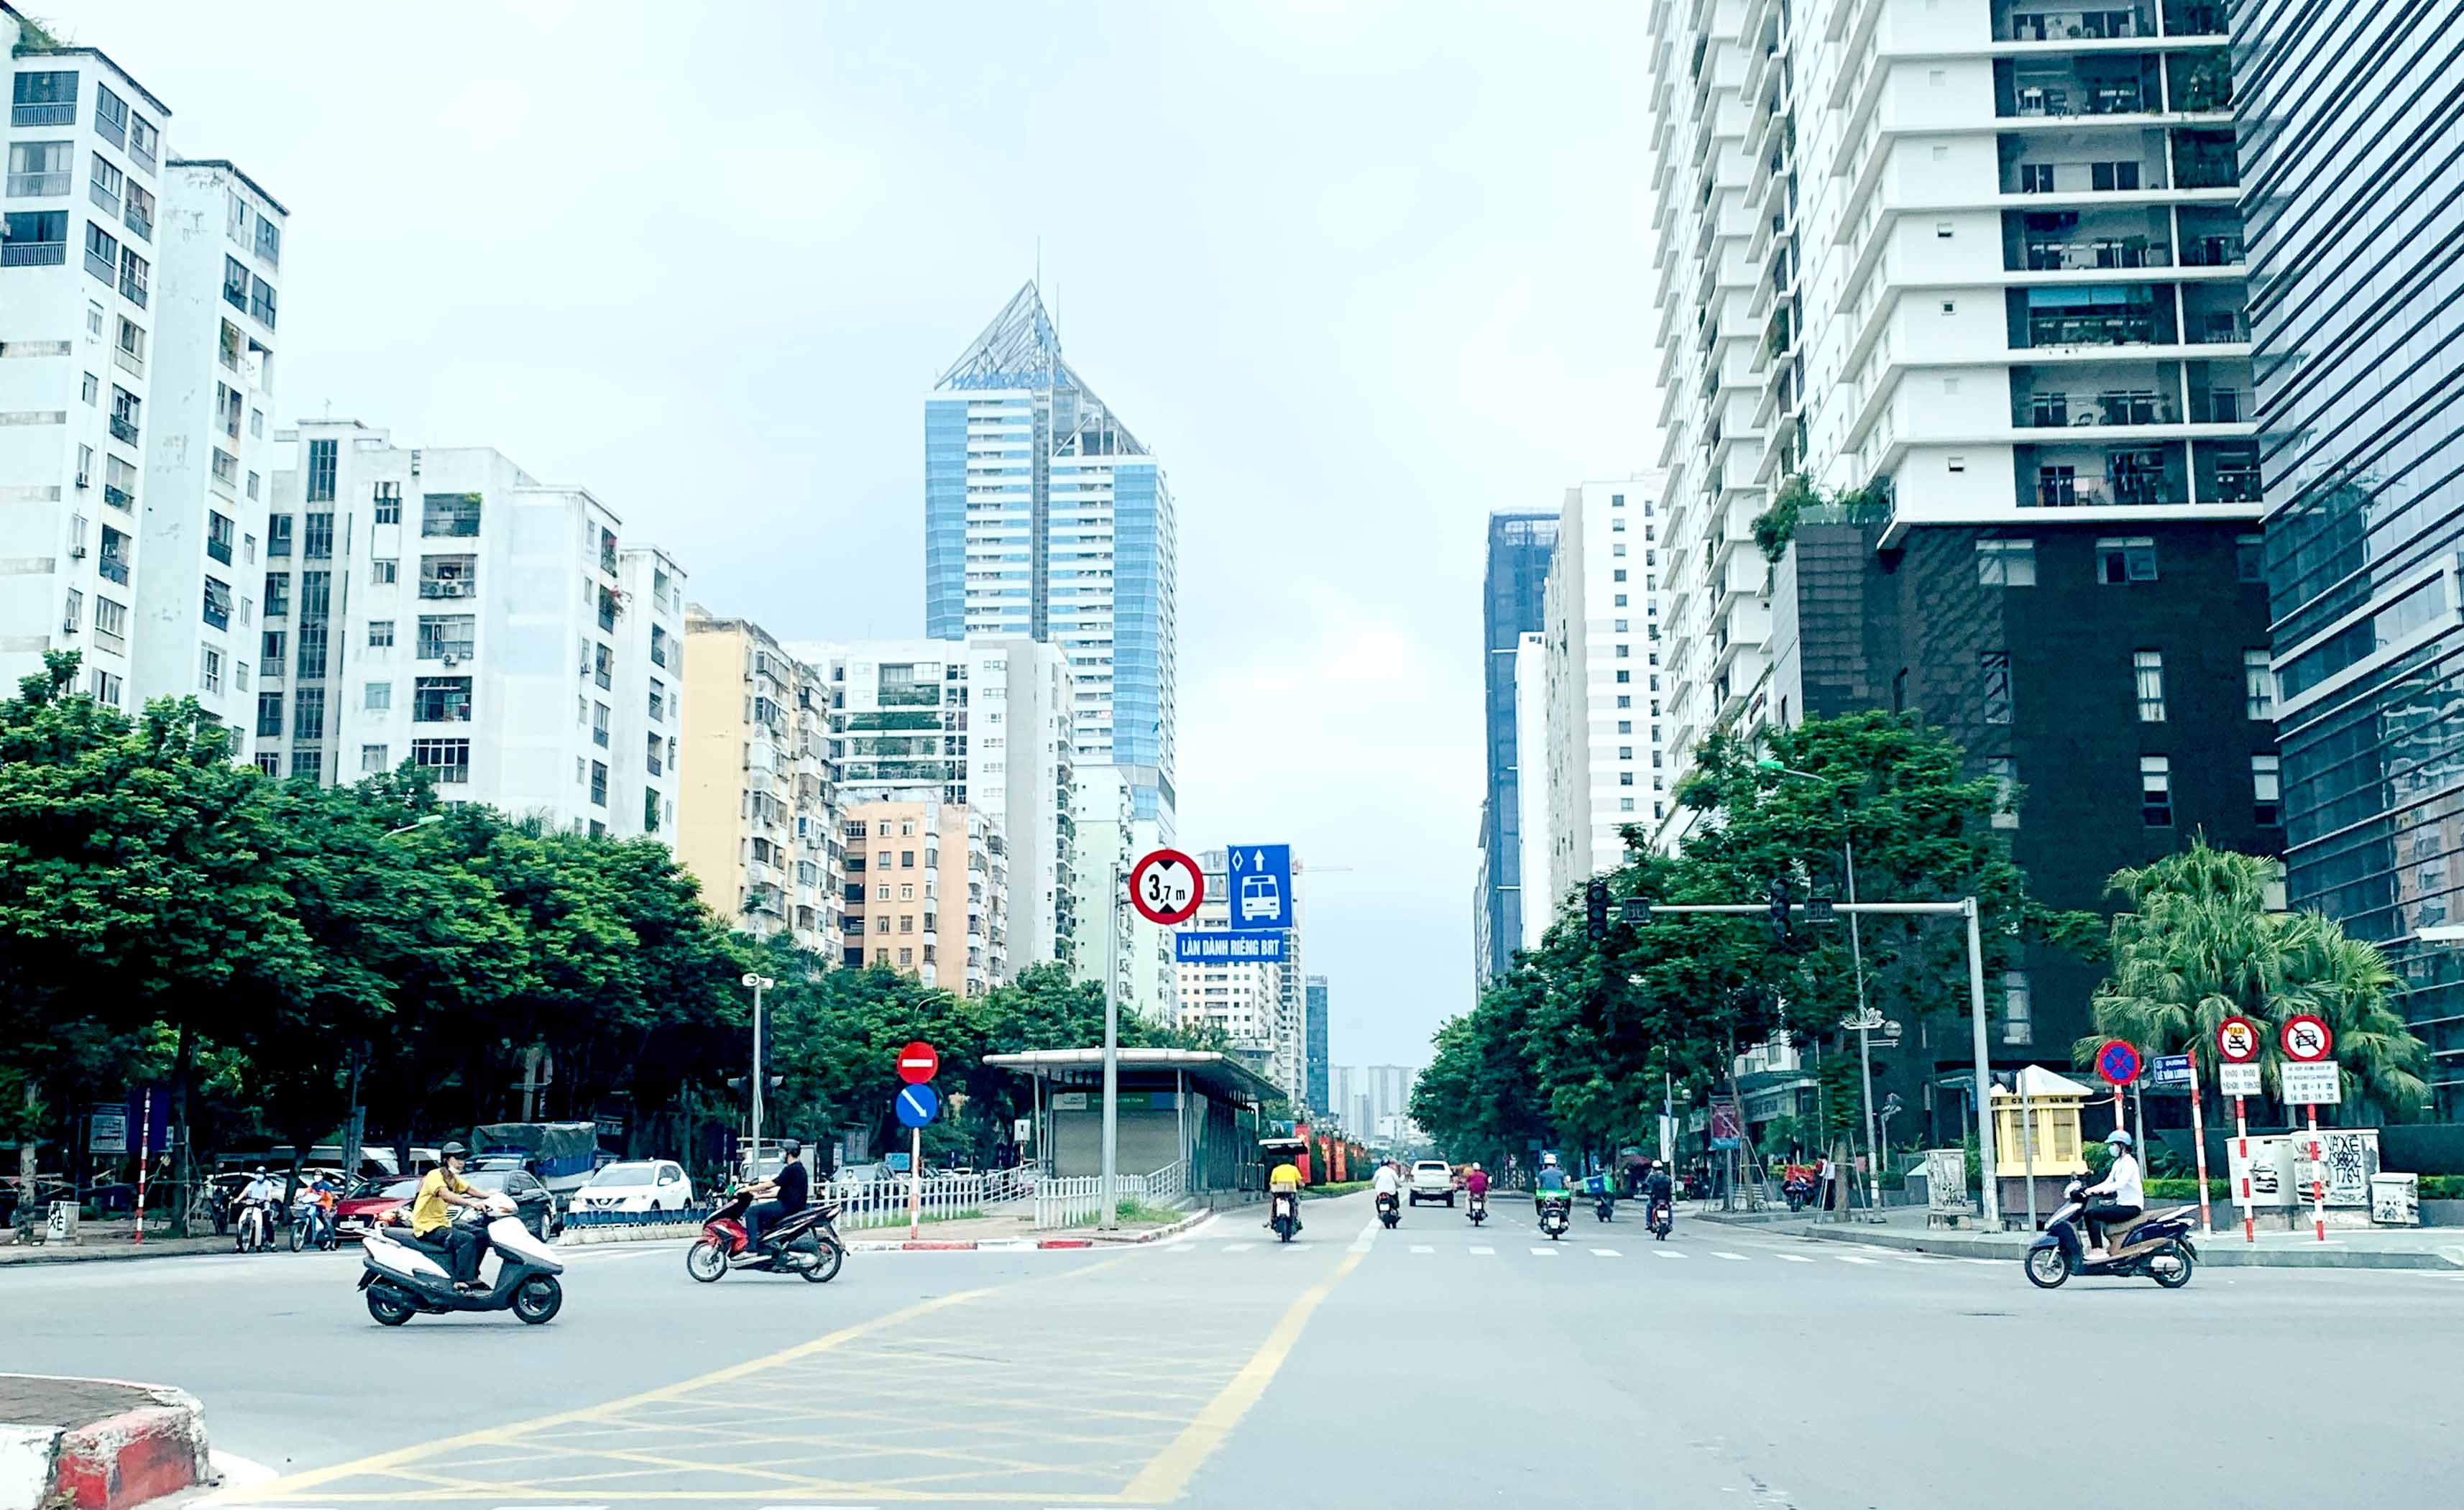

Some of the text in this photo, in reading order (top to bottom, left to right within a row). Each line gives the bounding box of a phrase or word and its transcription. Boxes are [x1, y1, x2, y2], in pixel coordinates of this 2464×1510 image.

[1149, 873, 1185, 904] 3,7 m
[1181, 935, 1279, 956] LÀN DÀNH RIÊNG BRT
